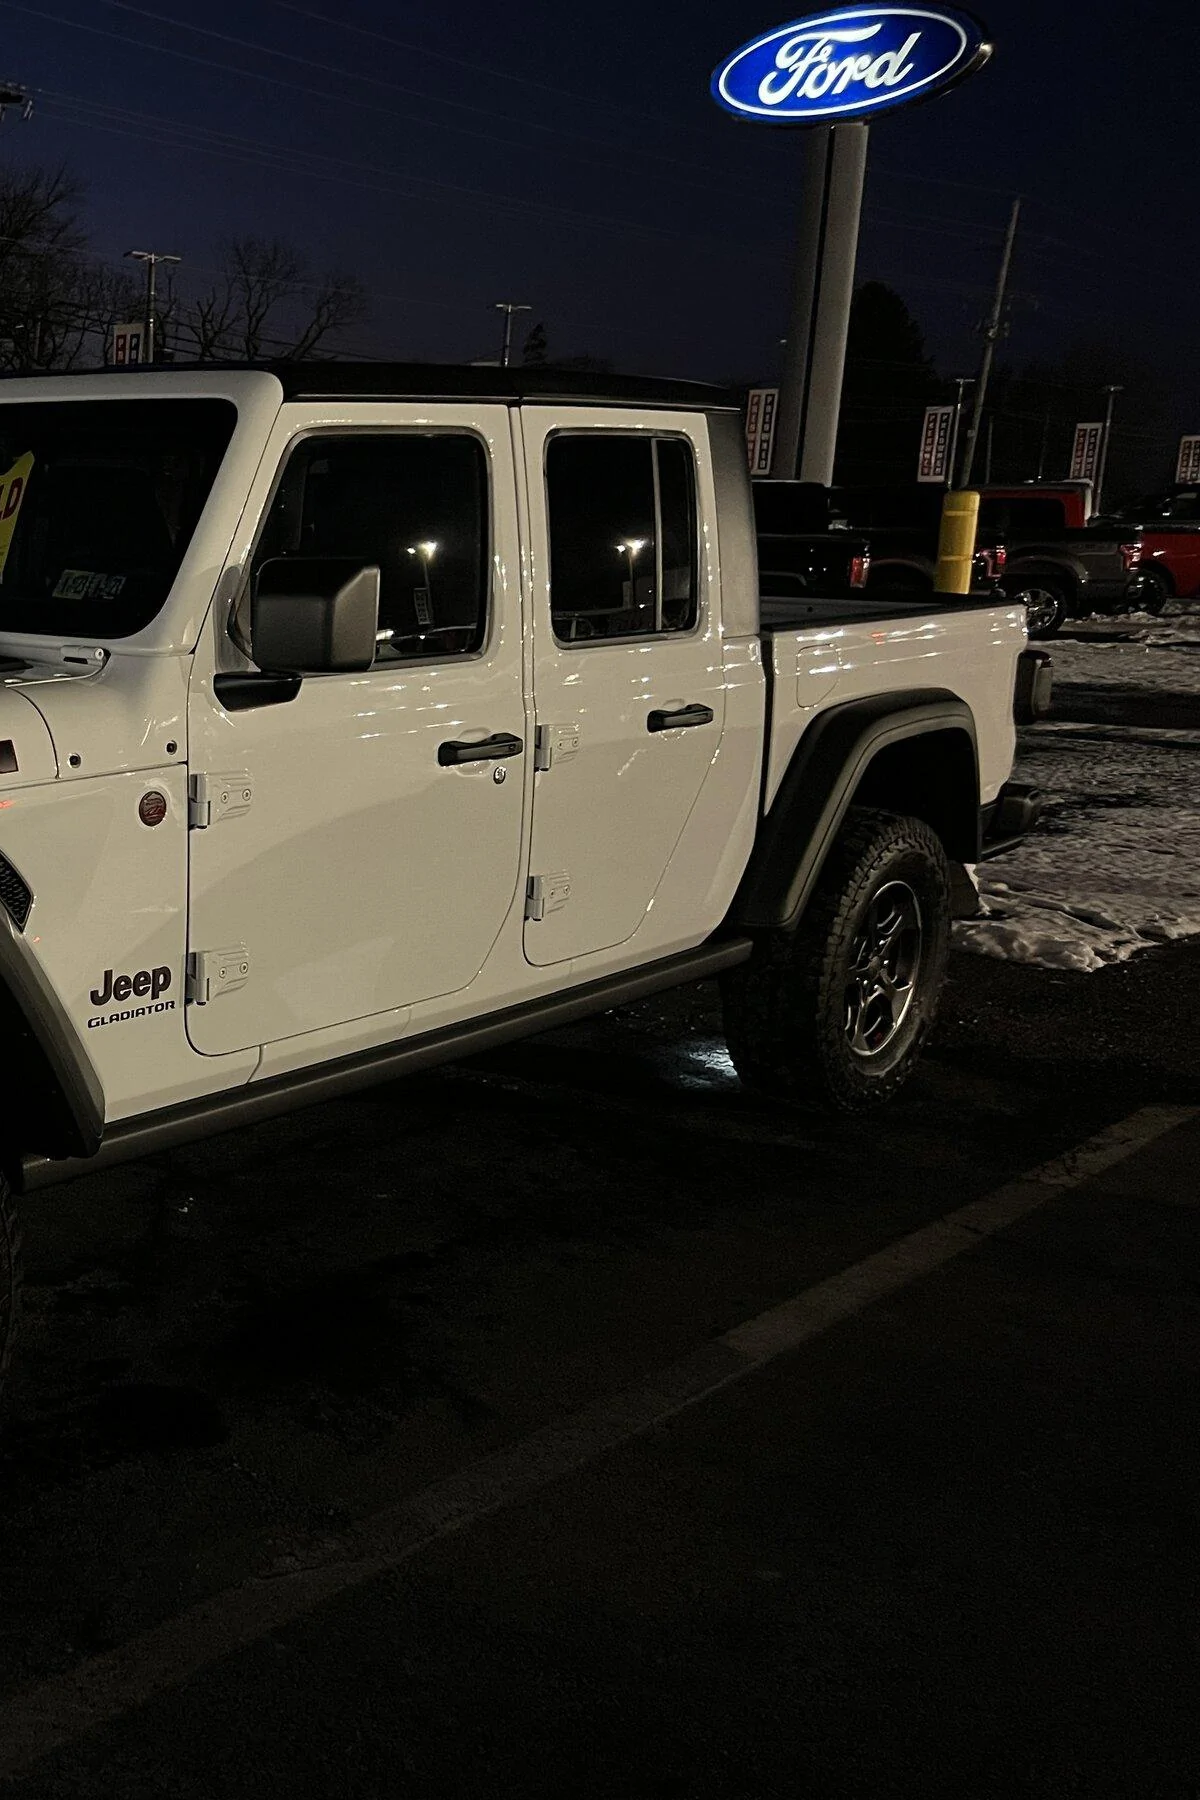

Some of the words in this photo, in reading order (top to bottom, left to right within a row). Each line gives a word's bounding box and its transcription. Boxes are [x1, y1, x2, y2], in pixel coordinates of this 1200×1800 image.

[758, 23, 922, 105] Ford
[90, 966, 172, 1006] Jeep
[87, 1000, 176, 1029] GLADIATOR
